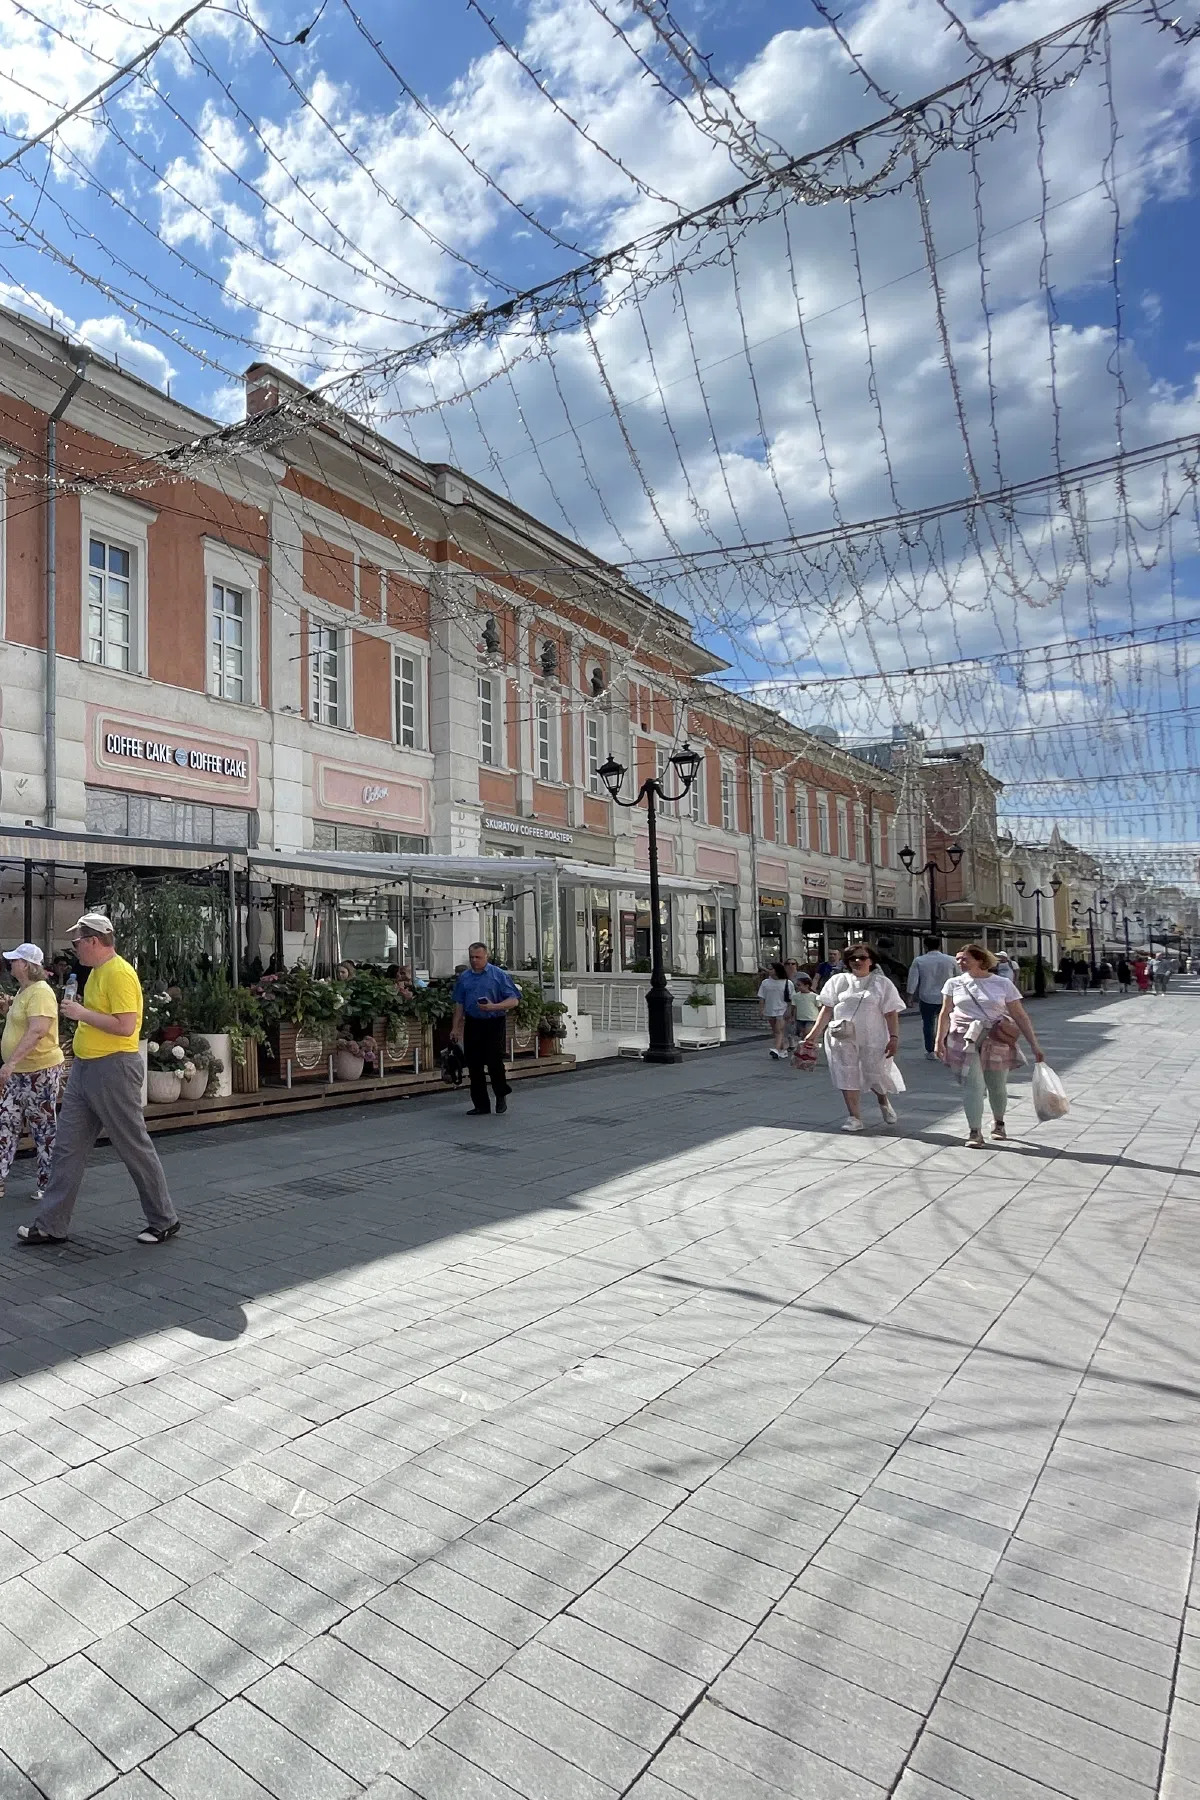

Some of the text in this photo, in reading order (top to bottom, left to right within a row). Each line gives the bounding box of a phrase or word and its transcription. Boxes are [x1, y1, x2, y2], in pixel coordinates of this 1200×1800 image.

[107, 733, 247, 778] COFFEE CAKE COFFEE CAKE
[485, 818, 574, 844] SKURATOV COFFEE ROASTERS
